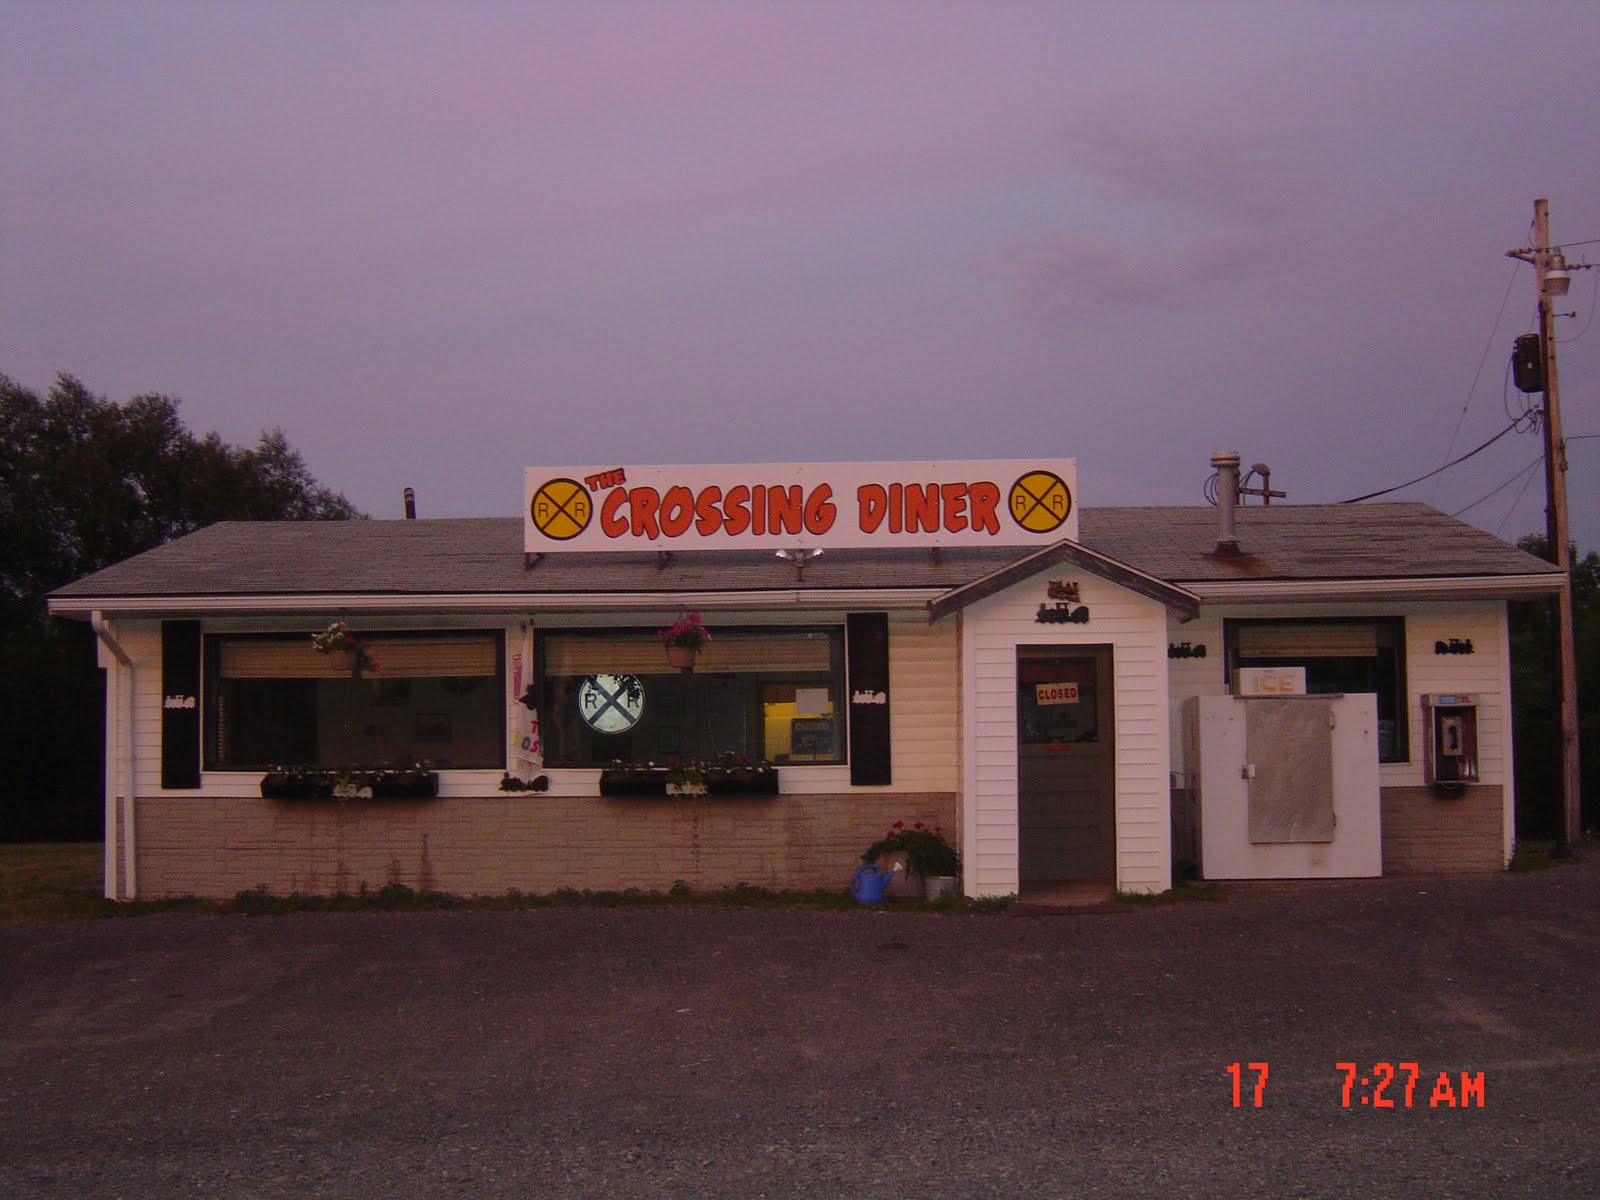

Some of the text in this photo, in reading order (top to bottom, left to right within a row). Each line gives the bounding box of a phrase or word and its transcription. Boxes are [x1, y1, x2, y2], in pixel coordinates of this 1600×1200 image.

[584, 467, 627, 492] THE
[600, 481, 1001, 540] CROSSING DINER
[1038, 687, 1077, 700] CLOSED
[1253, 676, 1296, 693] ICE
